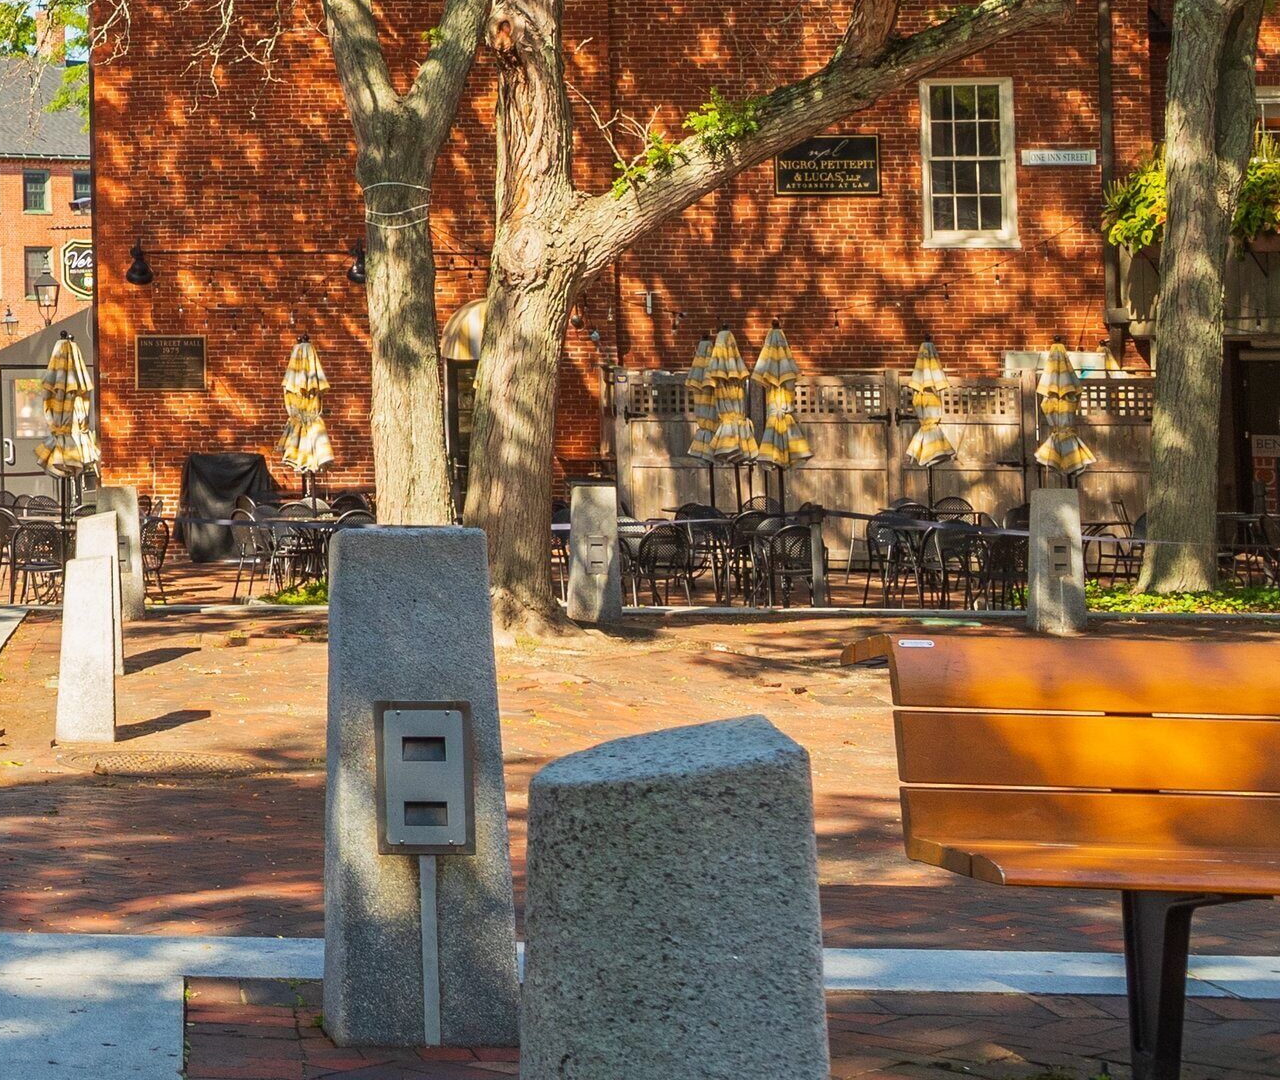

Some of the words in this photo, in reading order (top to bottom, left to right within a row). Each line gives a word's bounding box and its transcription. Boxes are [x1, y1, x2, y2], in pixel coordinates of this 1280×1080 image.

[1031, 153, 1045, 162] ONE
[1047, 153, 1061, 162] INN
[1062, 153, 1089, 162] STREET
[780, 160, 819, 171] NIGRO,
[793, 172, 803, 182] &
